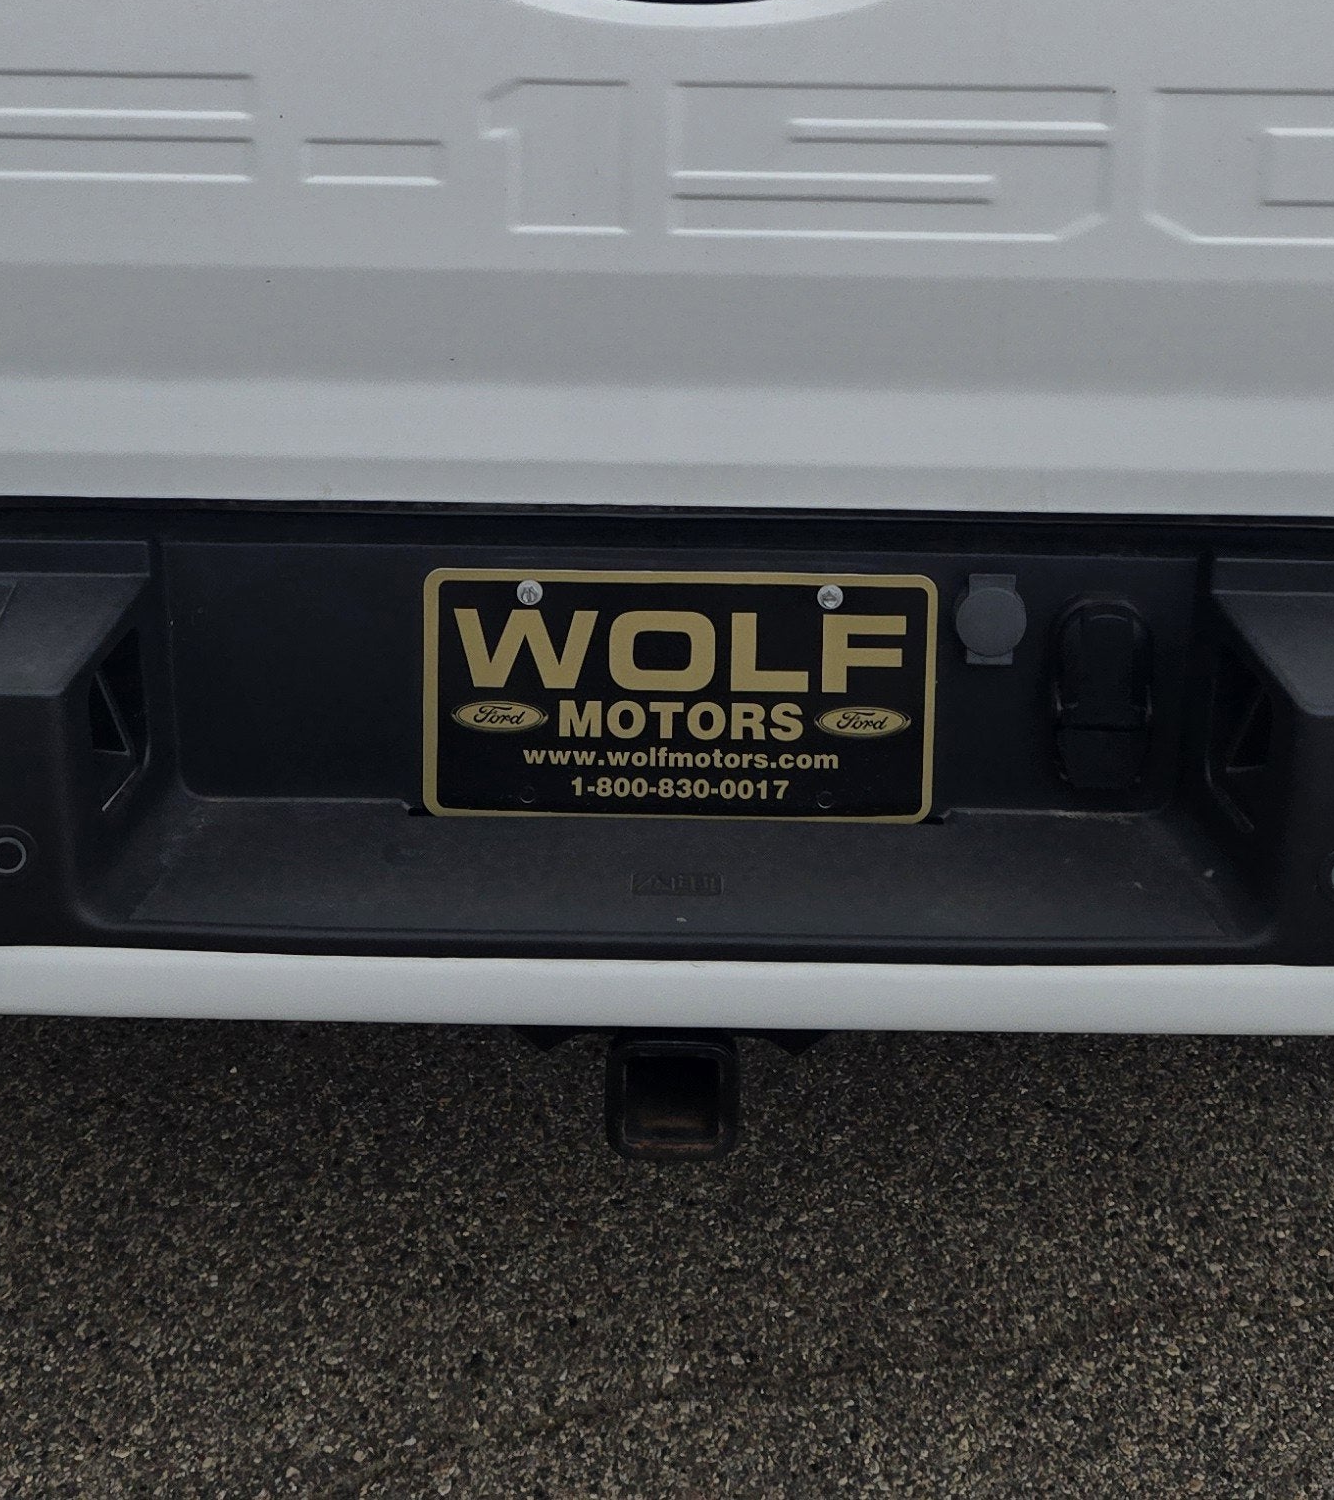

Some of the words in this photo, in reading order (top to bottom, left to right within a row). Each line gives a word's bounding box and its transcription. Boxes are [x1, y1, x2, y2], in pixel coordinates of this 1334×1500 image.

[453, 608, 908, 694] WOLF
[473, 705, 526, 725] Ford
[558, 699, 804, 741] MOTORS
[836, 711, 889, 730] Ford
[523, 747, 839, 770] www.wolfmotors.com
[571, 776, 790, 800] 1-800-830-0017
